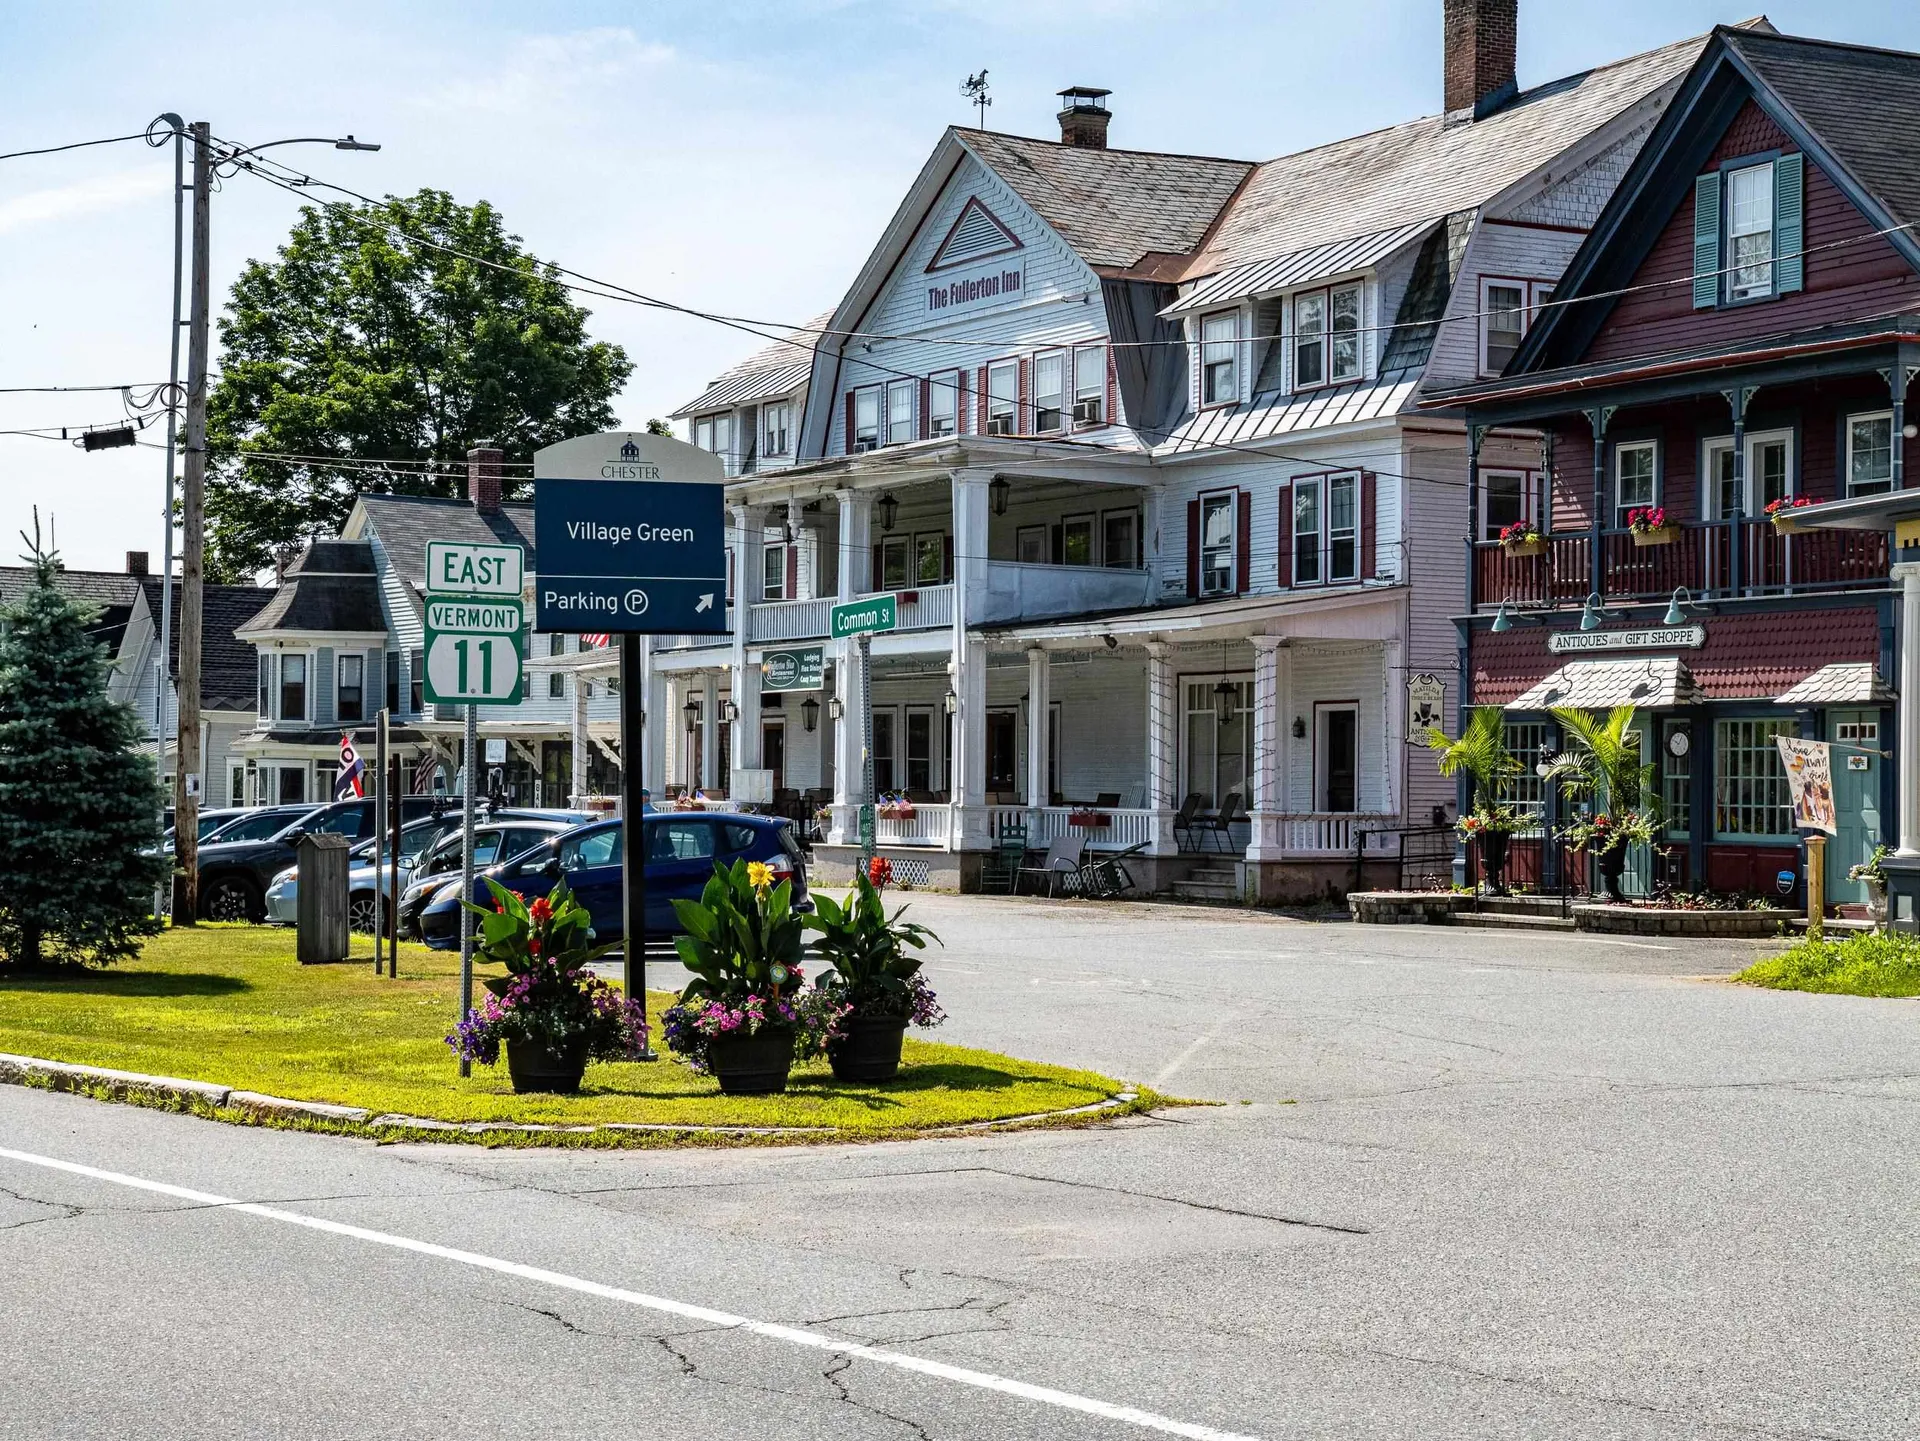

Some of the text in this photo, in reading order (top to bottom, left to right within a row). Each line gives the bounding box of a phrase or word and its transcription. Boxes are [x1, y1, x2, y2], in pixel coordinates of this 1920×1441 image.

[928, 270, 1020, 311] The Fullerton Inn
[601, 465, 661, 480] CHESTER
[566, 521, 694, 545] Village Green
[444, 552, 506, 586] EAST
[544, 591, 618, 615] Parking
[432, 606, 516, 629] VERMONT
[838, 608, 890, 631] Common St
[1555, 630, 1694, 649] ANTIQUES and GIFT SHOPPE
[454, 639, 493, 695] 11
